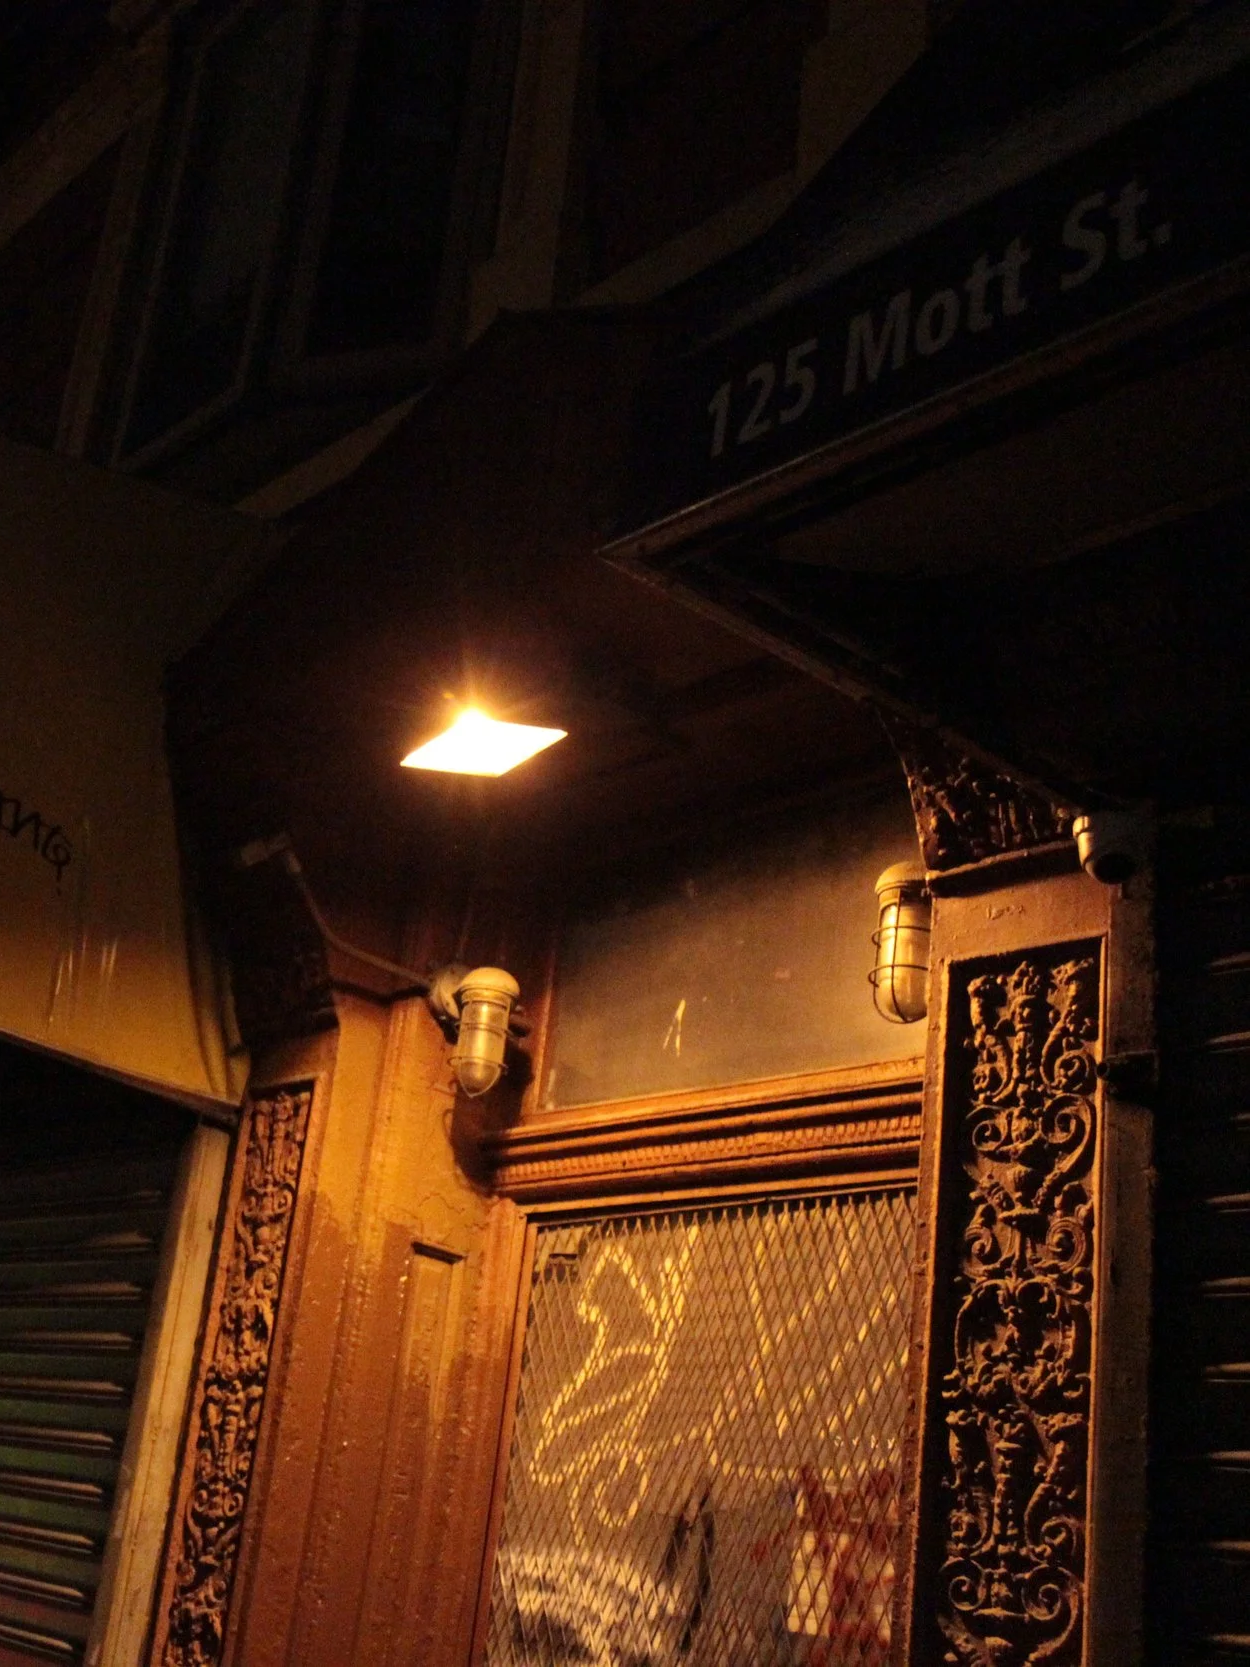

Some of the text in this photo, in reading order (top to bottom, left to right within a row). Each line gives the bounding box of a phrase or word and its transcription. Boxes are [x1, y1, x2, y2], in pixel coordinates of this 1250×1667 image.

[707, 172, 1173, 459] 125 Mott St.
